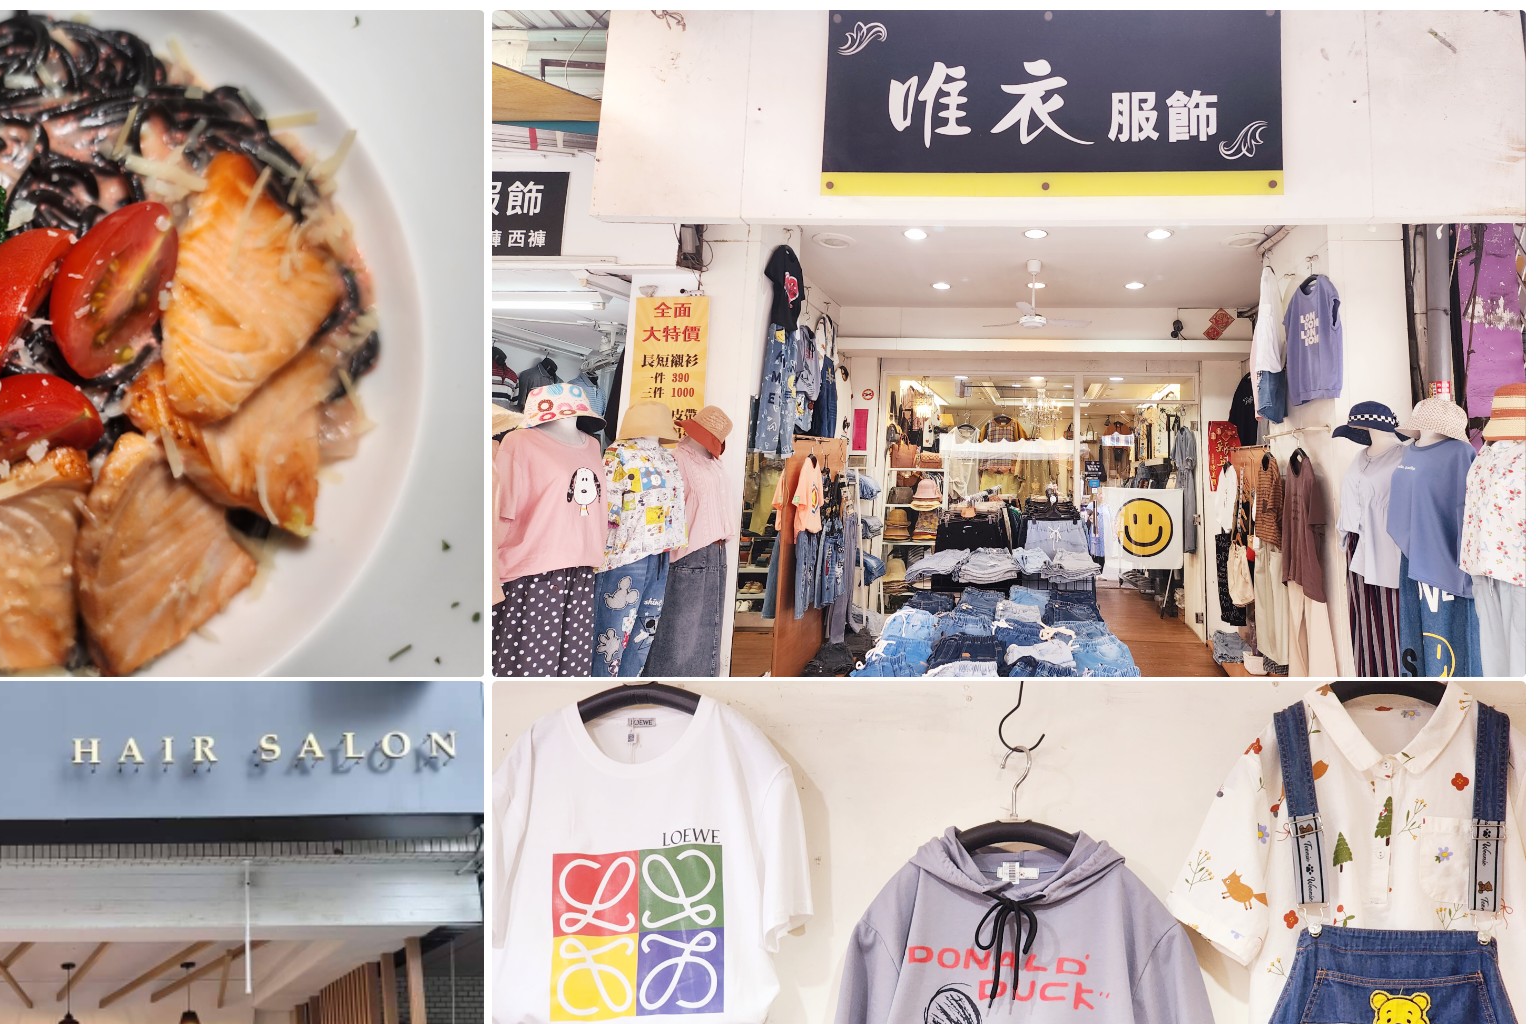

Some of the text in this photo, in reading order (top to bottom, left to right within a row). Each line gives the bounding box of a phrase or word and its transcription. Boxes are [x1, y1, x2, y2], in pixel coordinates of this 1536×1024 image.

[886, 59, 1218, 148] 唯衣 服飾
[507, 229, 547, 248] 西褲
[653, 302, 692, 318] 全面
[642, 325, 702, 343] 大特價
[641, 353, 700, 368] 長短襯衫
[647, 372, 691, 385] 一件 390
[640, 387, 696, 399] 三件 1000
[72, 729, 461, 767] HAIR SALON
[662, 827, 722, 847] LOEWE
